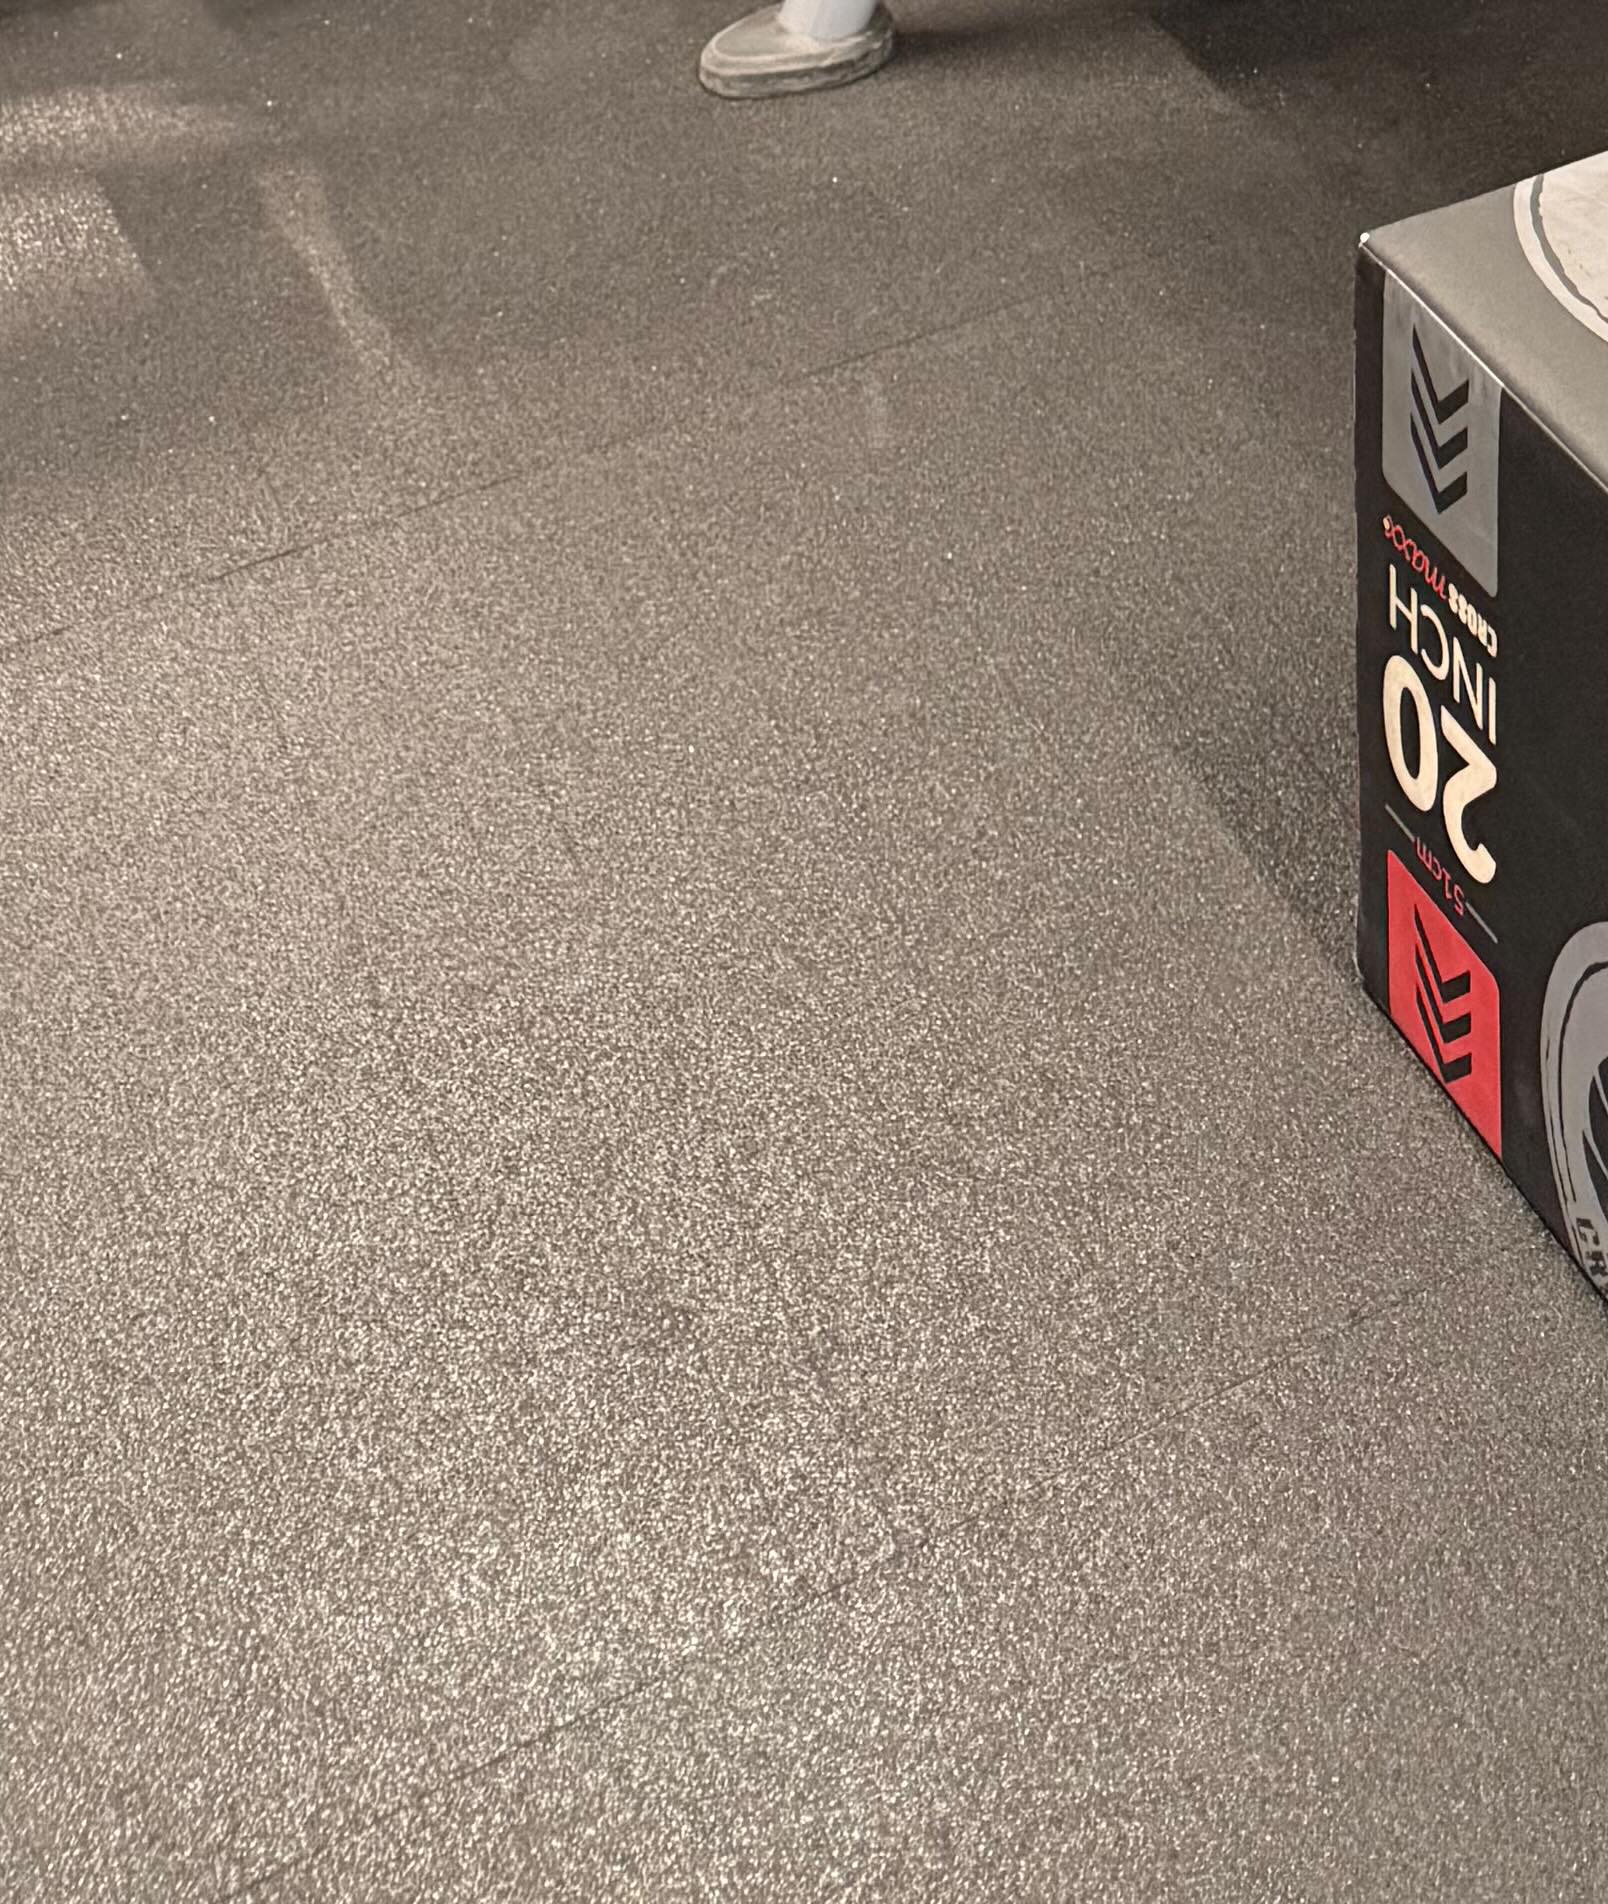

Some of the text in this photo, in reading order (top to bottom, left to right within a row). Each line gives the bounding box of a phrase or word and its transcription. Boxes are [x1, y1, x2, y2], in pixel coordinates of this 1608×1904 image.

[1389, 564, 1497, 745] INCH
[1383, 655, 1498, 884] 20
[1415, 836, 1466, 917] 51cm
